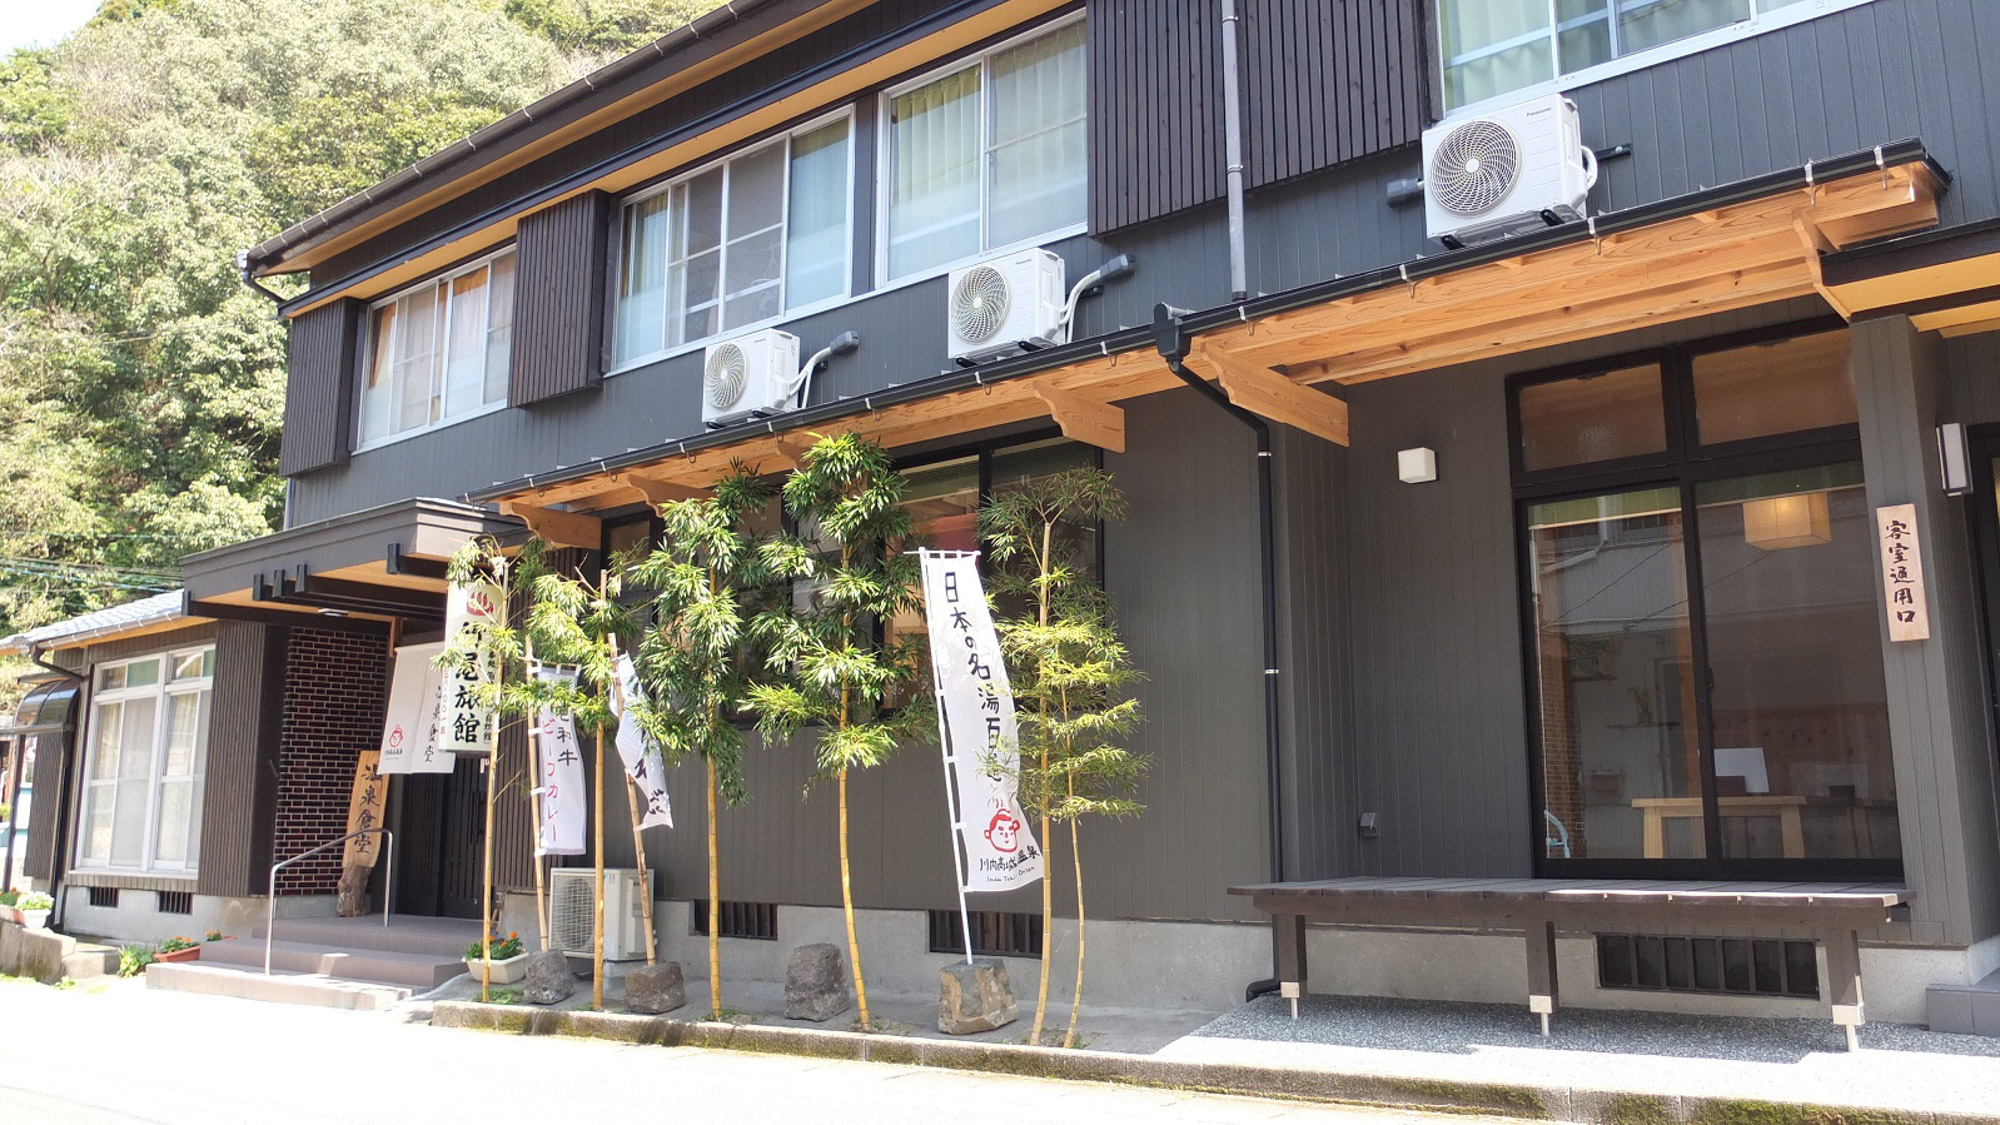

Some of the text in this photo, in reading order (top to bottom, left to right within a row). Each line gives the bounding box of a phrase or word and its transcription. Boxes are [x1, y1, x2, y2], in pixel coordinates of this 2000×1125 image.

[1885, 520, 1915, 622] 客室通用口
